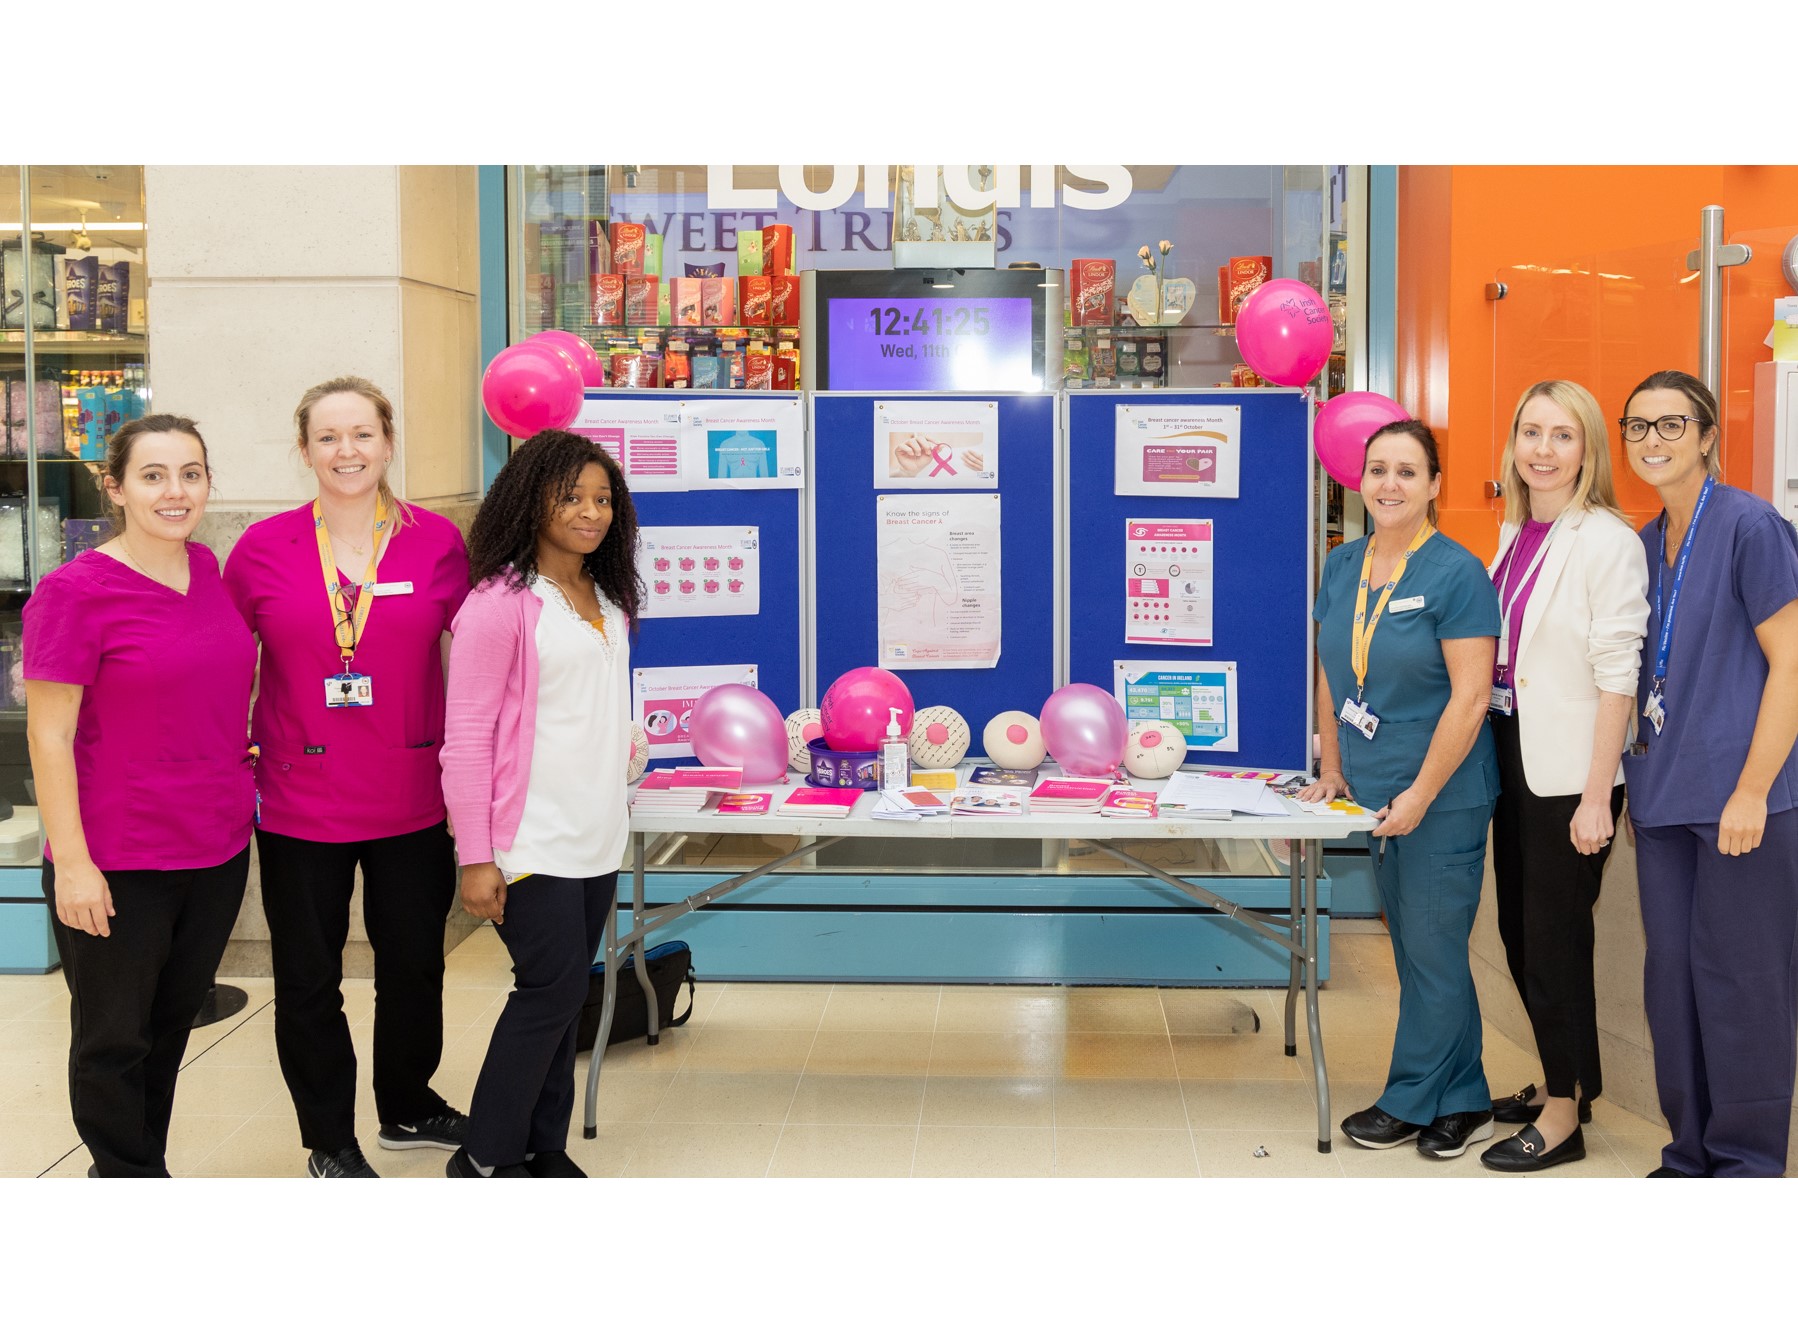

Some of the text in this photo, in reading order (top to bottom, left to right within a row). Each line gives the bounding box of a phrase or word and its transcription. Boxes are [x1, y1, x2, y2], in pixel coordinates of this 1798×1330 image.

[1300, 299, 1316, 307] Irish
[870, 307, 990, 336] 12:41:25
[1306, 316, 1329, 324] Society
[880, 343, 918, 359] Wed,
